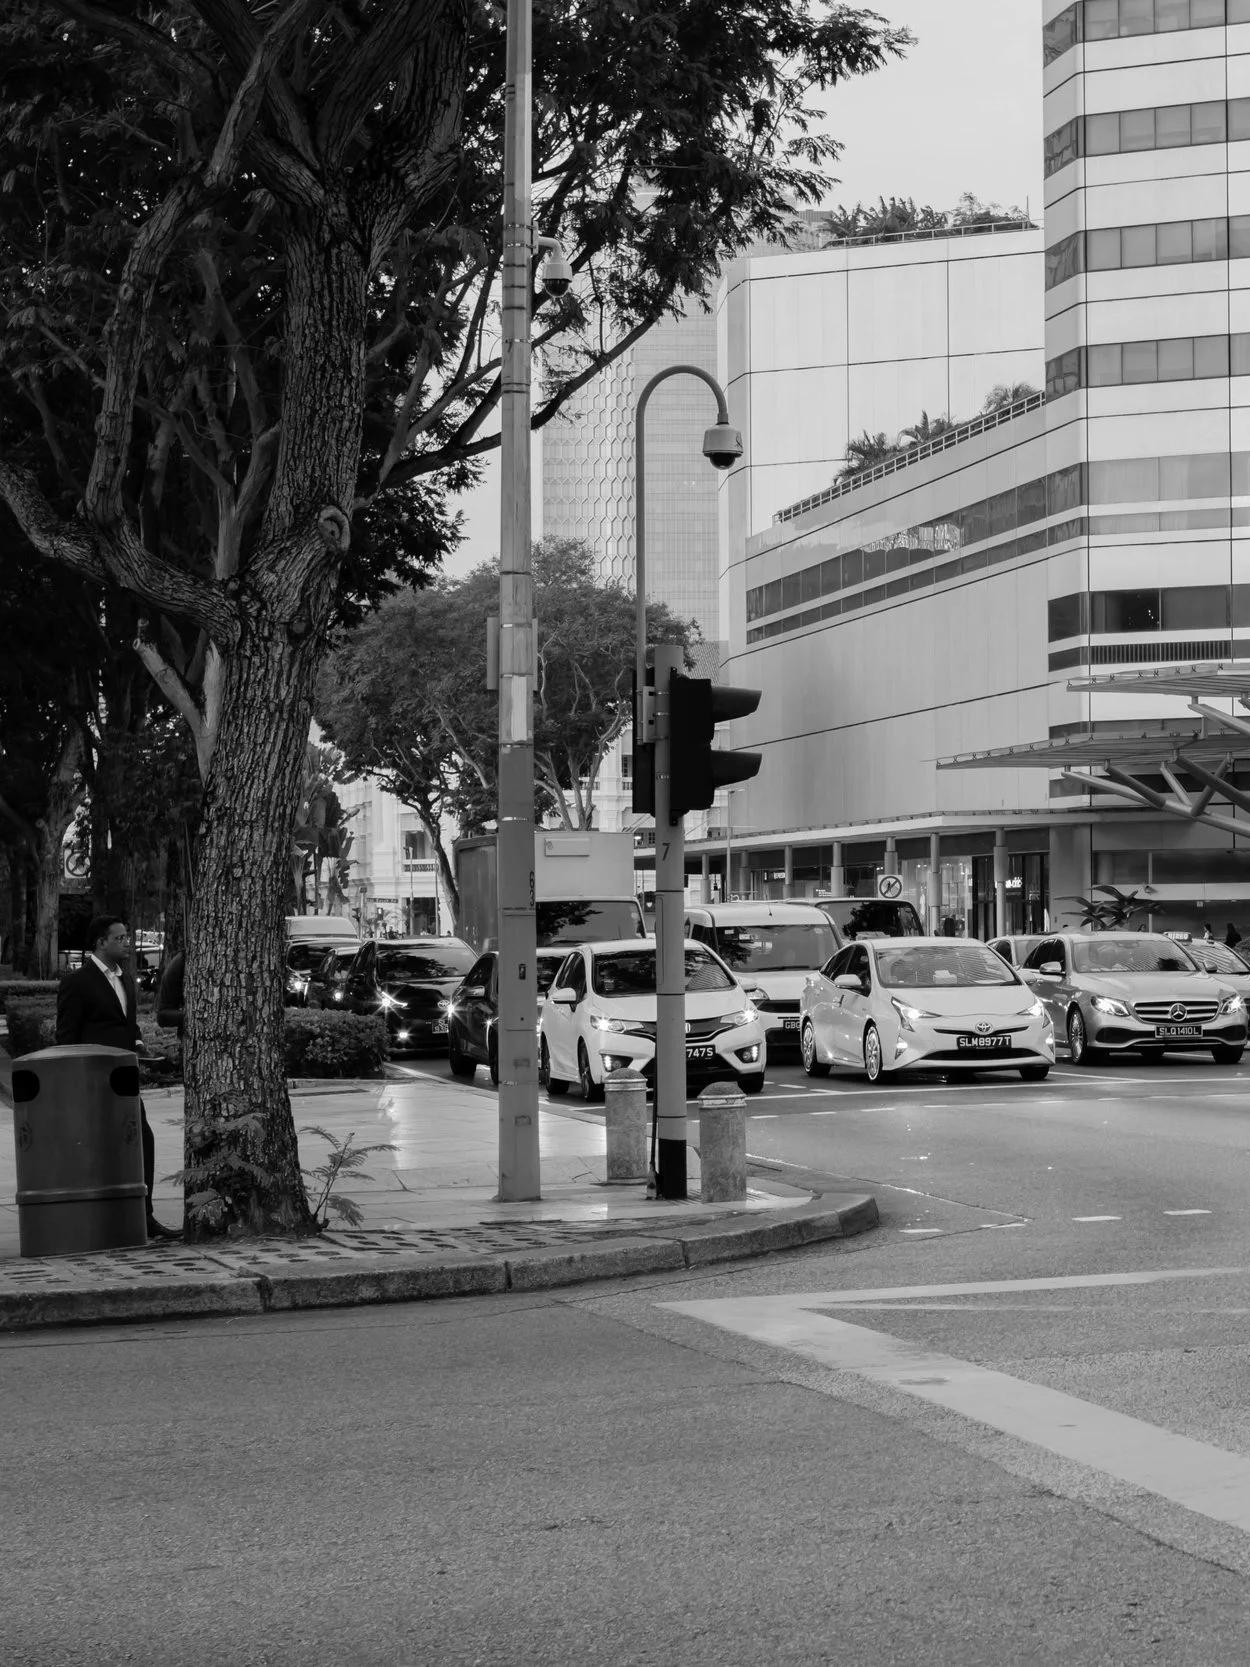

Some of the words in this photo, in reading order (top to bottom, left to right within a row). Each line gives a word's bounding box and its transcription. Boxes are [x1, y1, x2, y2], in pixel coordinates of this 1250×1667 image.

[662, 842, 671, 861] 7
[1159, 1026, 1199, 1035] SLQ1410L
[959, 1036, 1011, 1047] SLM8977T
[686, 1047, 714, 1058] 747S
